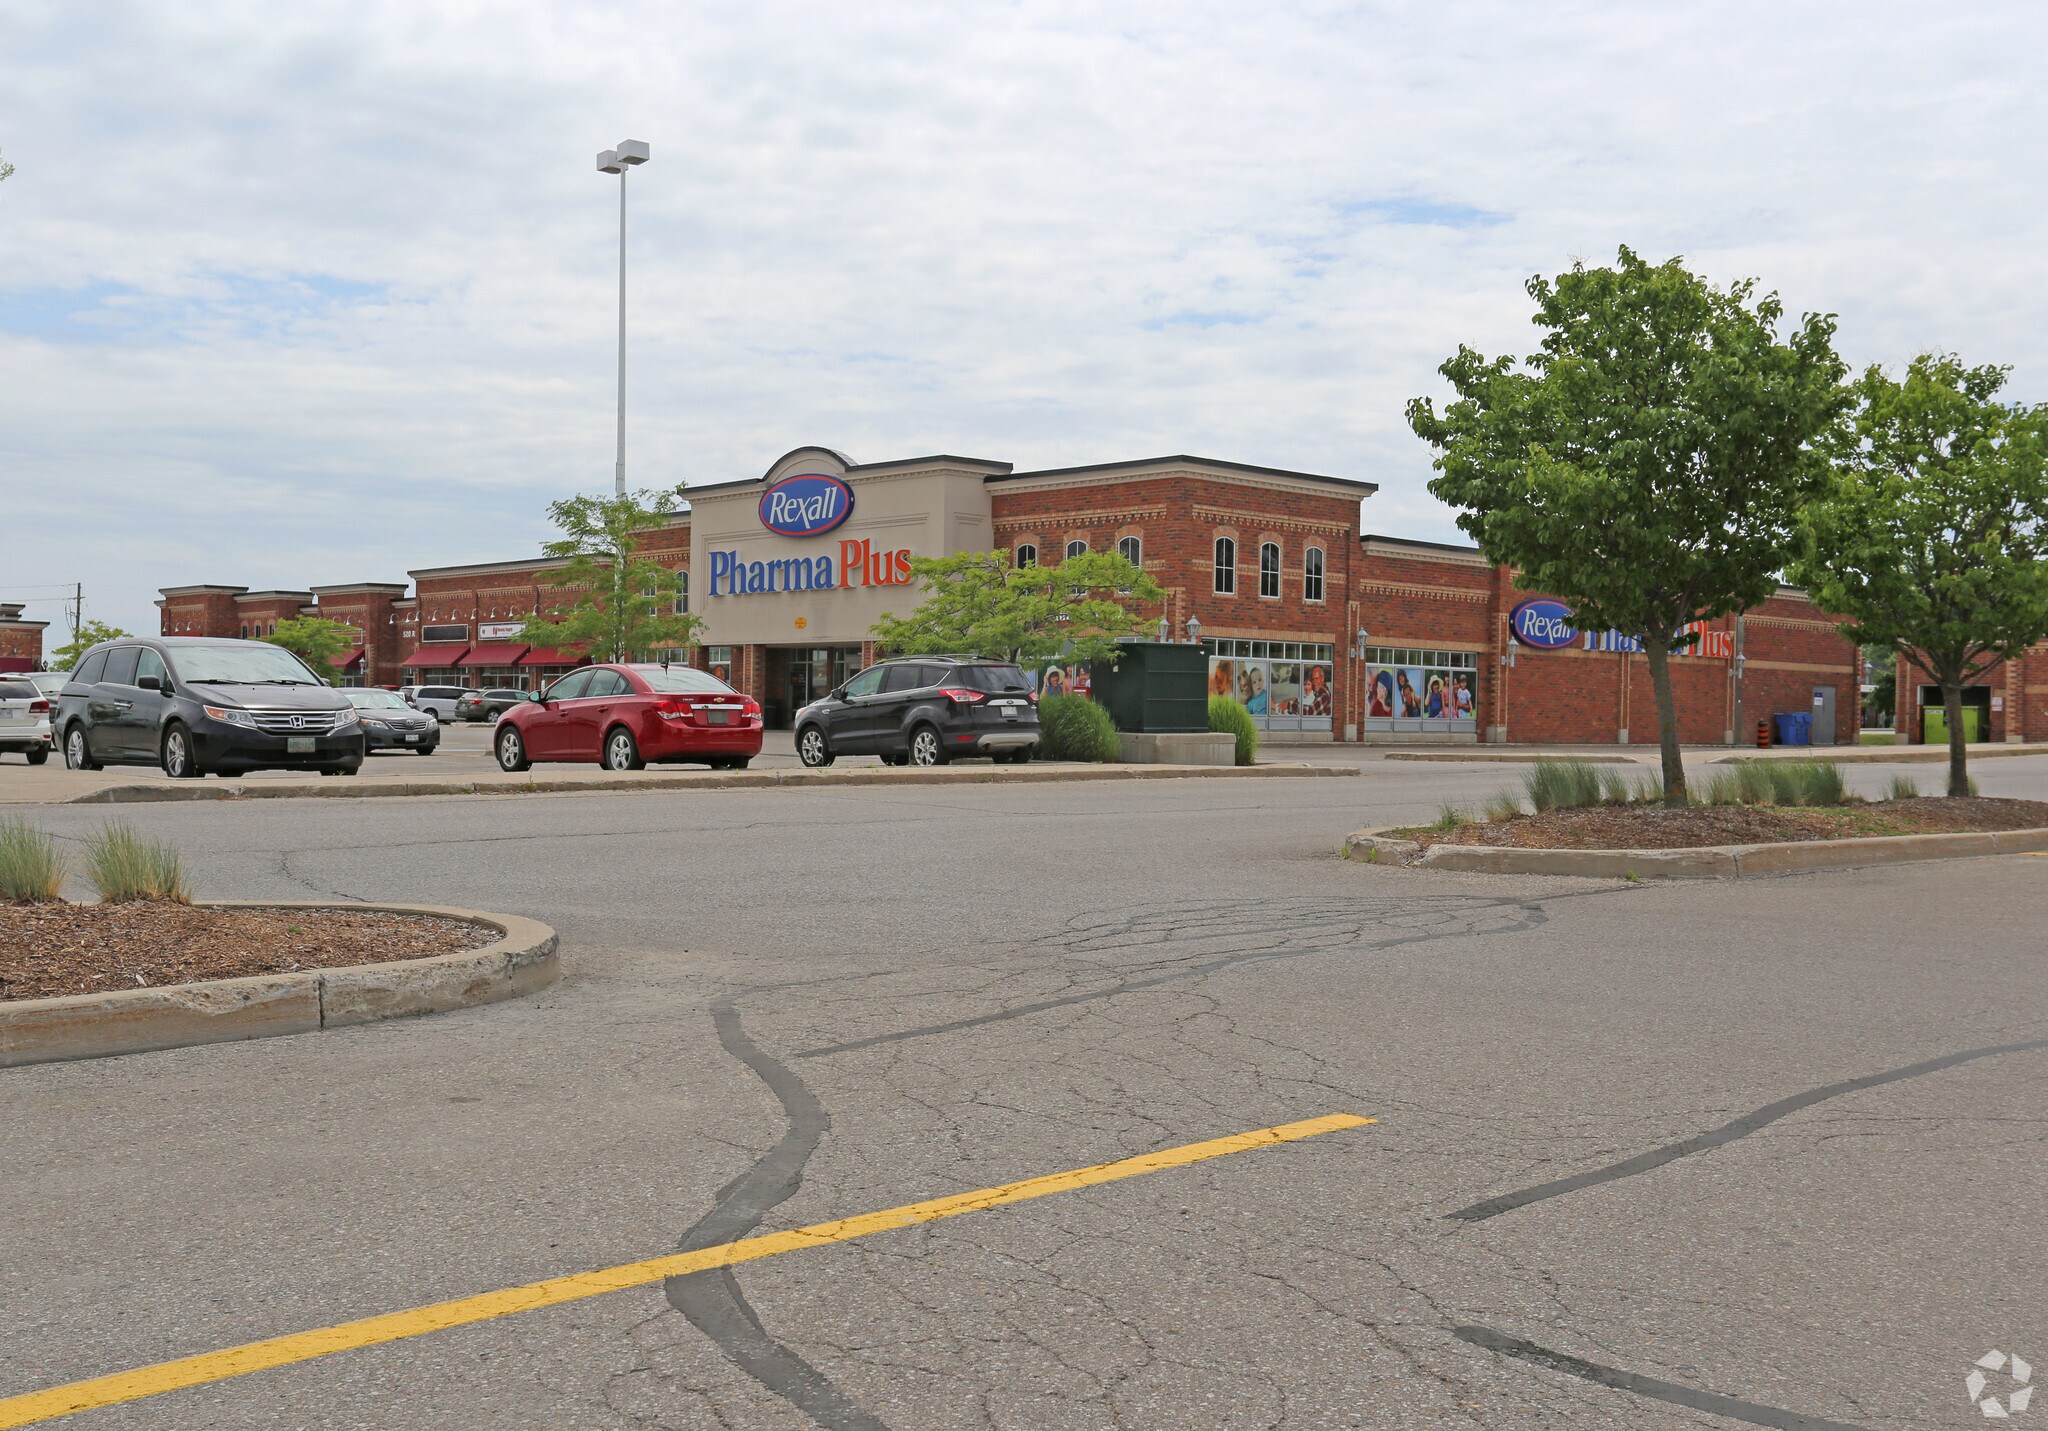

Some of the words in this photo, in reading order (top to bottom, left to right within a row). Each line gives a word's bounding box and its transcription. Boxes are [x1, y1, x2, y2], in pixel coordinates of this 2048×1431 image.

[769, 486, 838, 529] Rexall
[708, 549, 835, 596] Pharma
[838, 536, 912, 590] Plus
